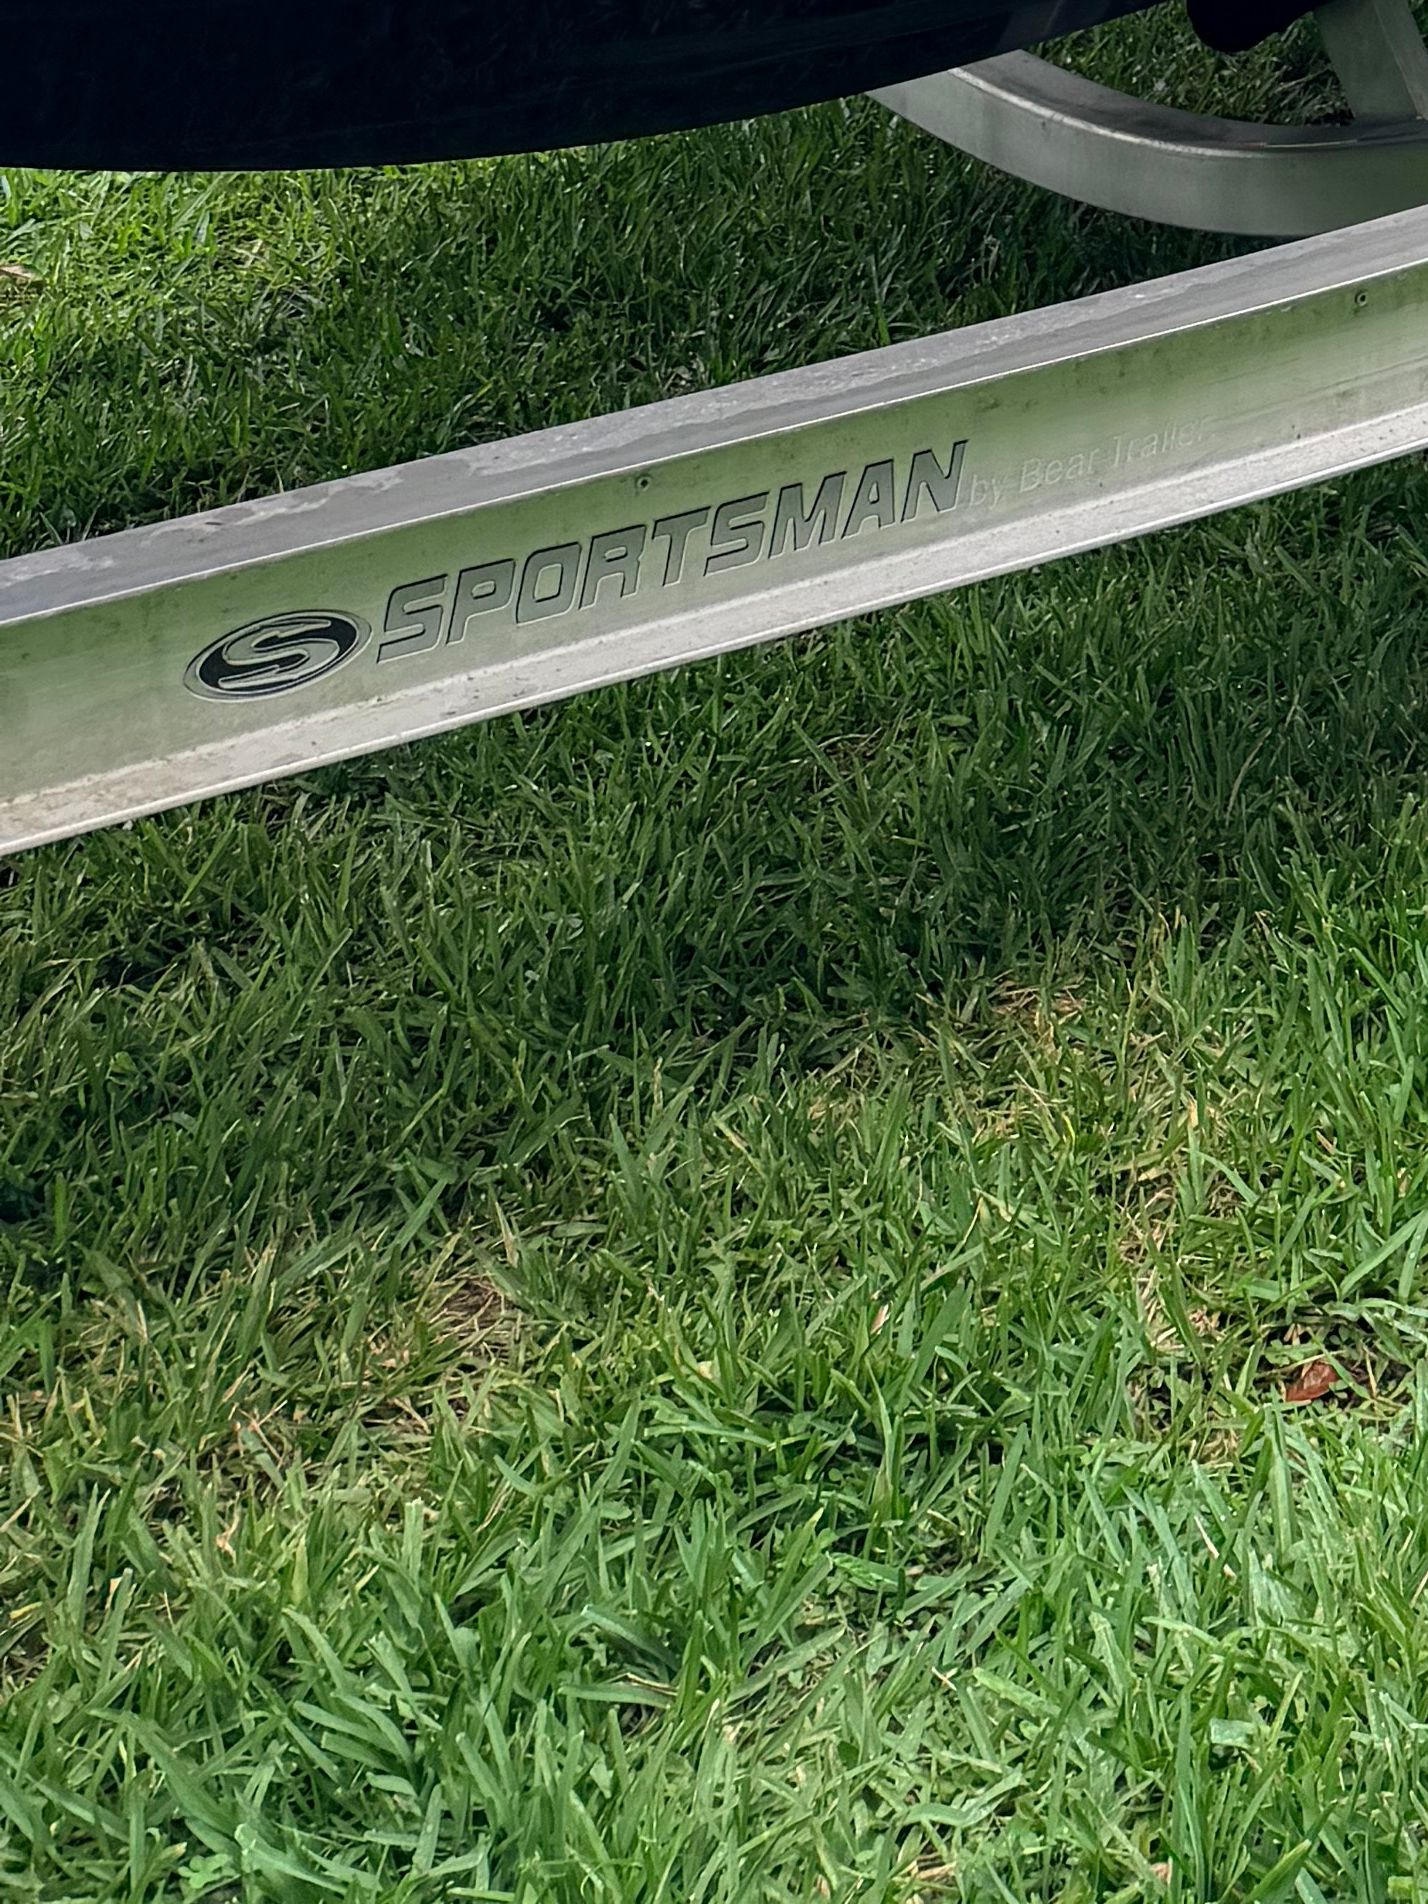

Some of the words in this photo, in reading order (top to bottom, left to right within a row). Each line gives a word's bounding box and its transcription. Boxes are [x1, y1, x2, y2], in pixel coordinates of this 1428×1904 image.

[376, 440, 967, 664] SPORTSMAN
[968, 474, 1008, 508] by
[1019, 448, 1097, 493] Bear
